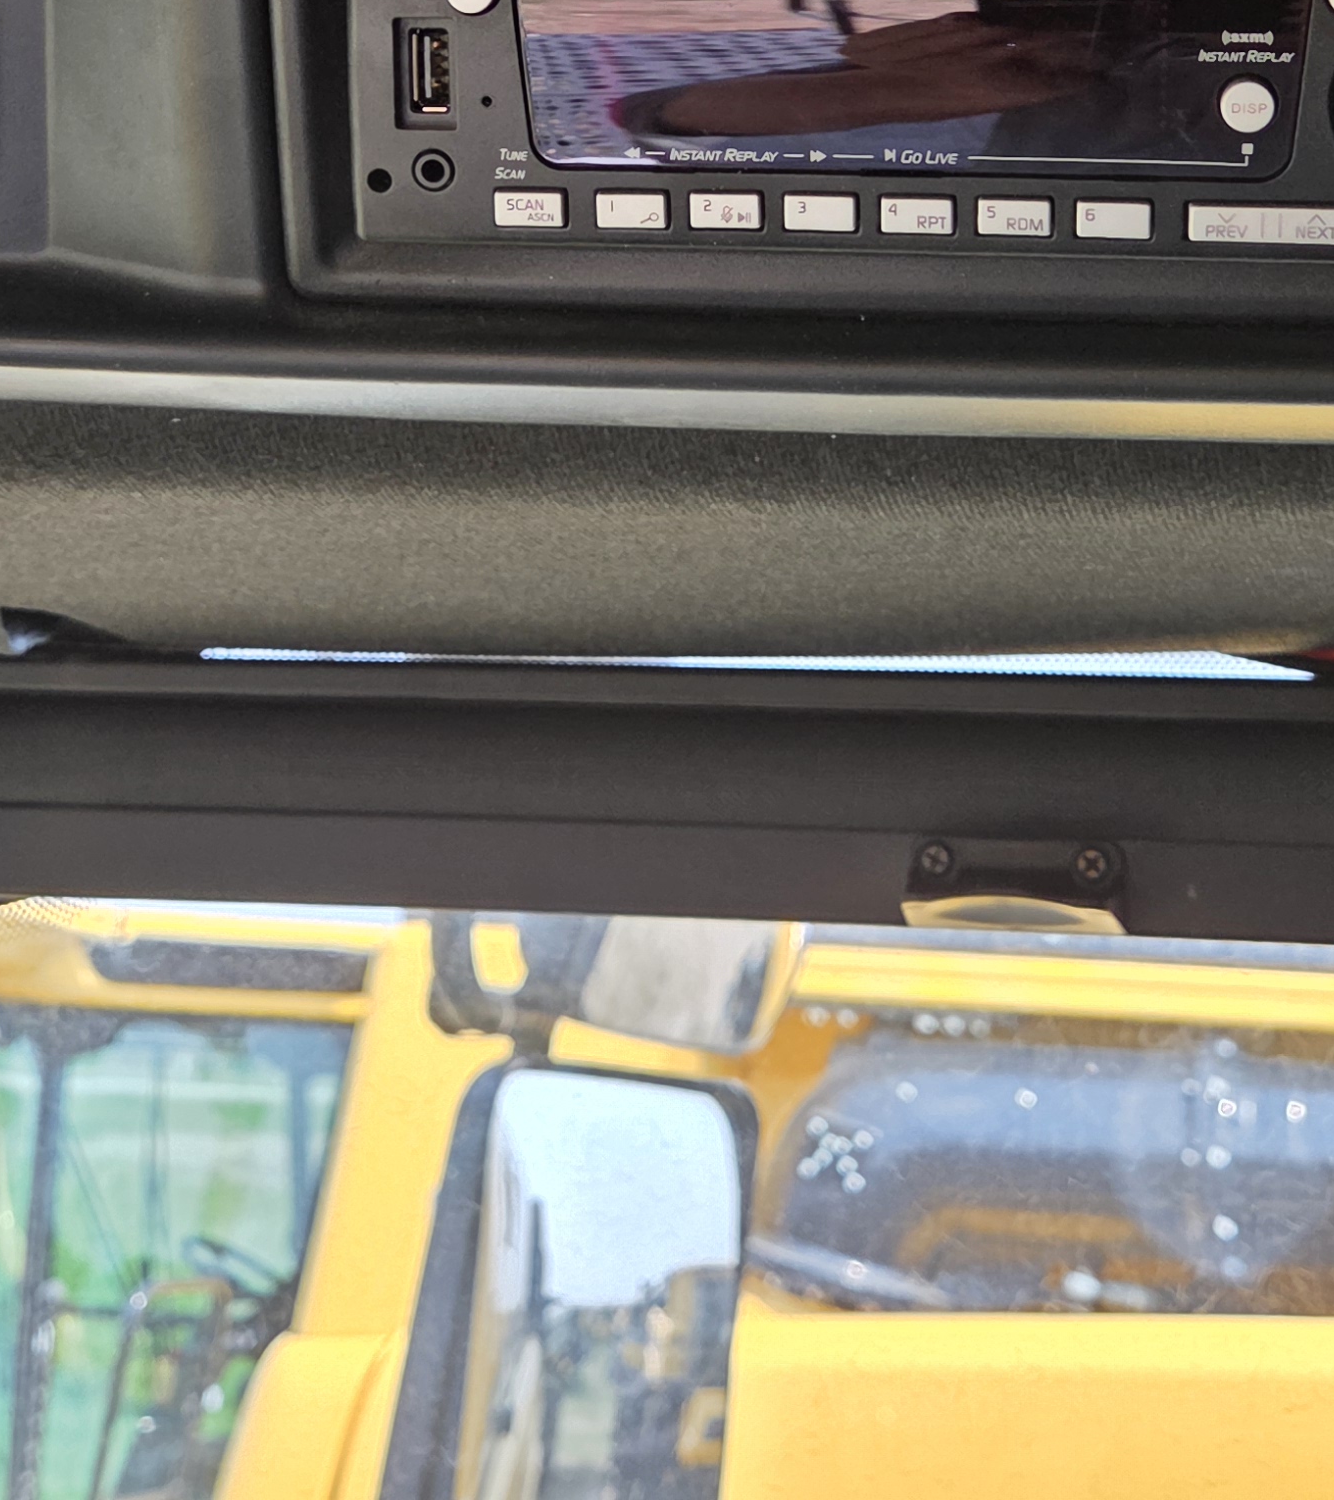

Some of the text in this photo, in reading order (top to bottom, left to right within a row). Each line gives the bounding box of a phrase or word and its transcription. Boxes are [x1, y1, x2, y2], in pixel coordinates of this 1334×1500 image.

[1231, 102, 1267, 114] DISP
[499, 148, 528, 162] TUNE
[495, 167, 526, 180] SCAN
[506, 198, 544, 211] SCAN
[703, 199, 711, 212] 2
[798, 202, 806, 214] 3
[888, 203, 897, 216] 4
[527, 211, 555, 222] ASCN
[987, 206, 995, 218] 5
[1085, 208, 1095, 221] 6
[917, 215, 947, 230] RPT
[1007, 217, 1044, 232] RDM
[1205, 224, 1248, 239] PREV
